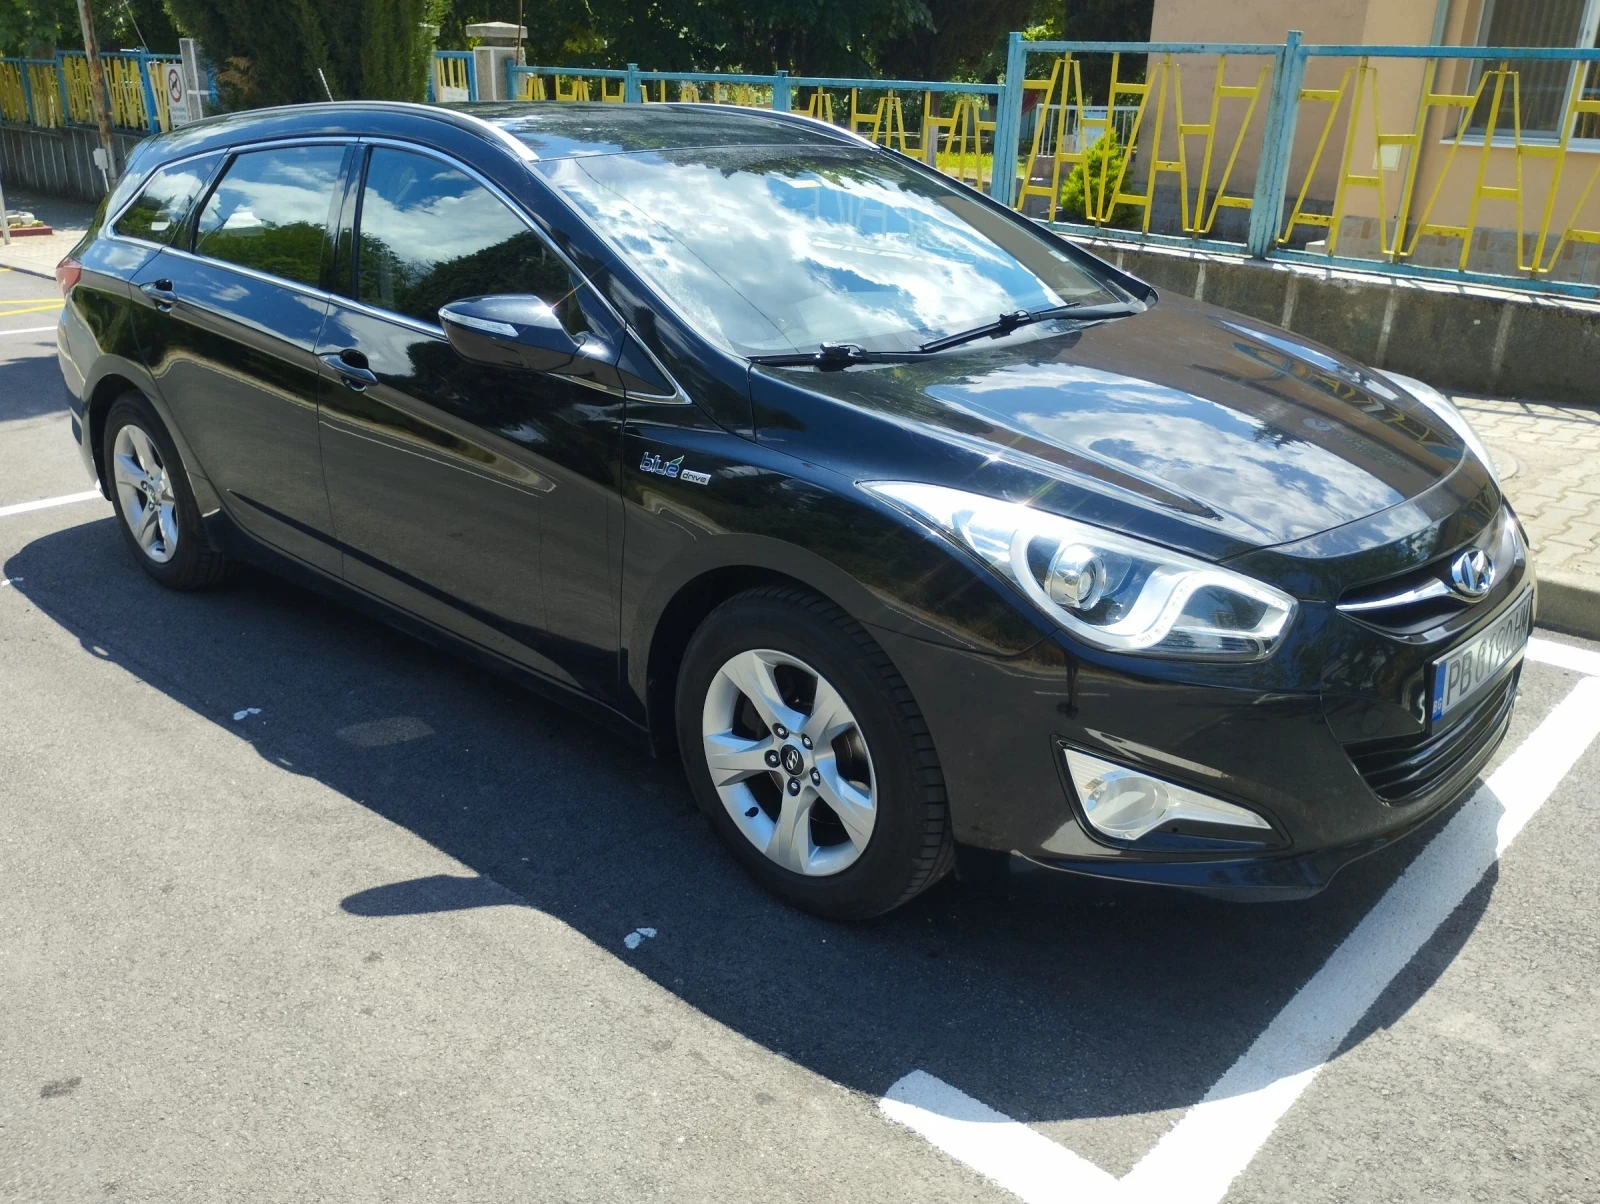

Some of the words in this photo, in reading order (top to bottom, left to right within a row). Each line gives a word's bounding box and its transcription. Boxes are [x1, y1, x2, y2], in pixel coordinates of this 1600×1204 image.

[640, 452, 680, 478] blue
[682, 471, 708, 484] drive
[1446, 651, 1473, 706] PB
[1433, 698, 1443, 714] BG
